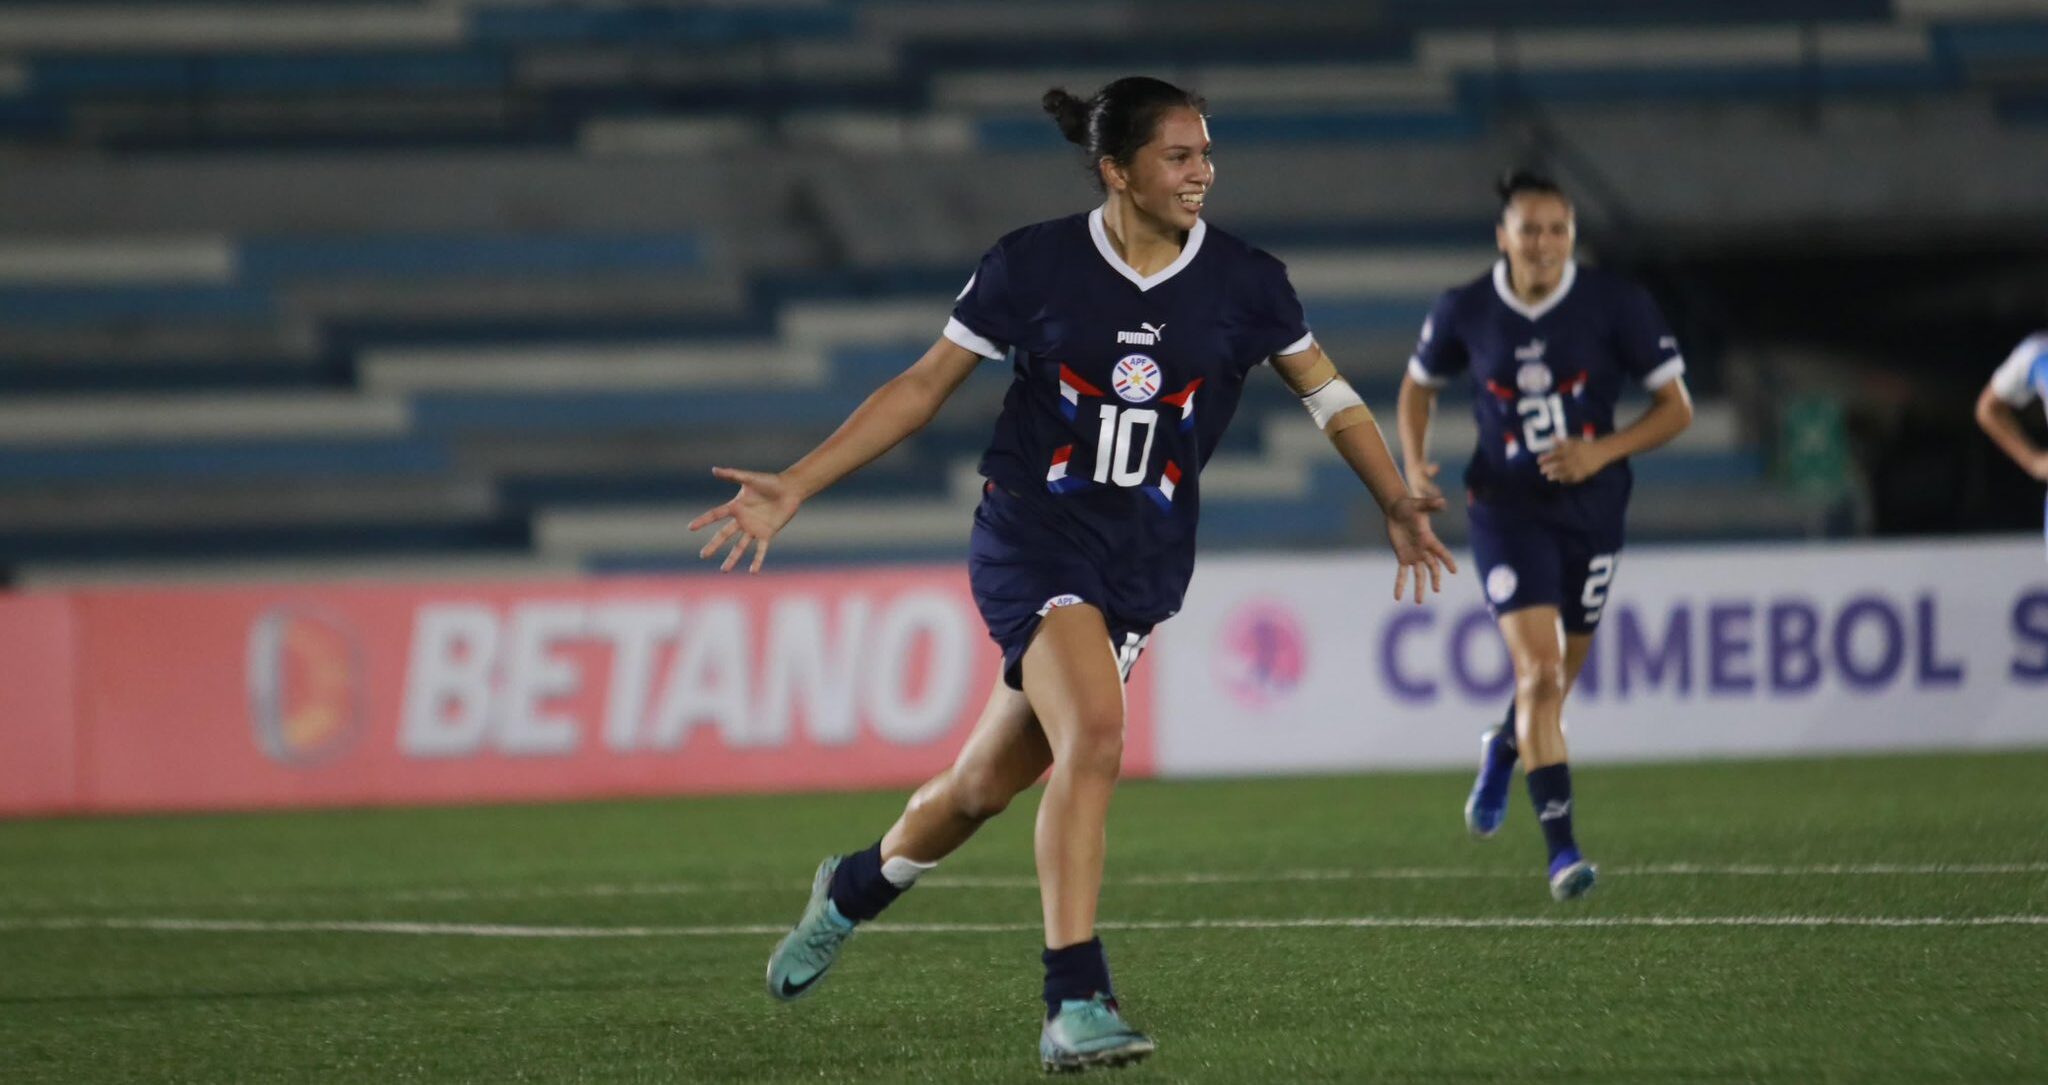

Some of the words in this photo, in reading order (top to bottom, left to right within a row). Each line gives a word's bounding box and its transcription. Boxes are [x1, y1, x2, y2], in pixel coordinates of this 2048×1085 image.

[1117, 331, 1155, 345] PUMA
[1130, 357, 1147, 366] APF
[1093, 404, 1159, 487] 10
[1517, 393, 1568, 454] 21
[400, 594, 972, 757] BETANO
[1378, 589, 1967, 705] COMEBOL
